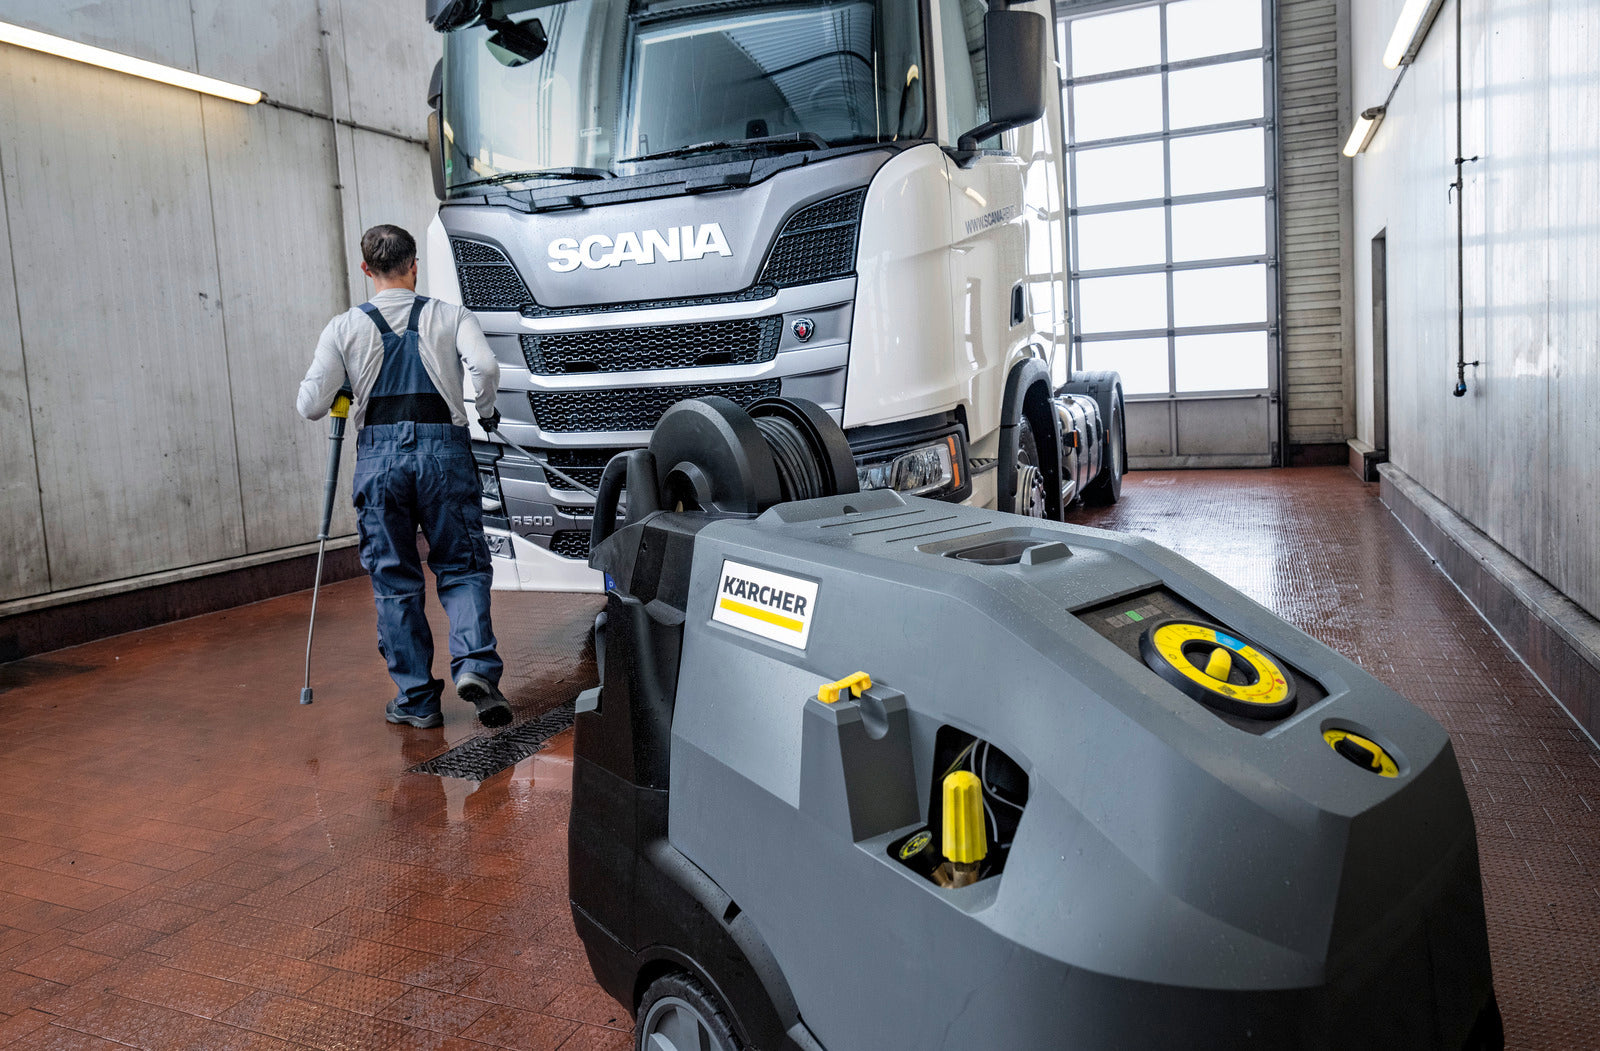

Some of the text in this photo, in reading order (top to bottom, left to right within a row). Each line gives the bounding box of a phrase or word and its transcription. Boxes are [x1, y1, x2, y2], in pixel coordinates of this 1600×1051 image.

[547, 222, 733, 273] SCANIA
[511, 515, 553, 526] R500
[722, 575, 808, 616] KÄRCHER
